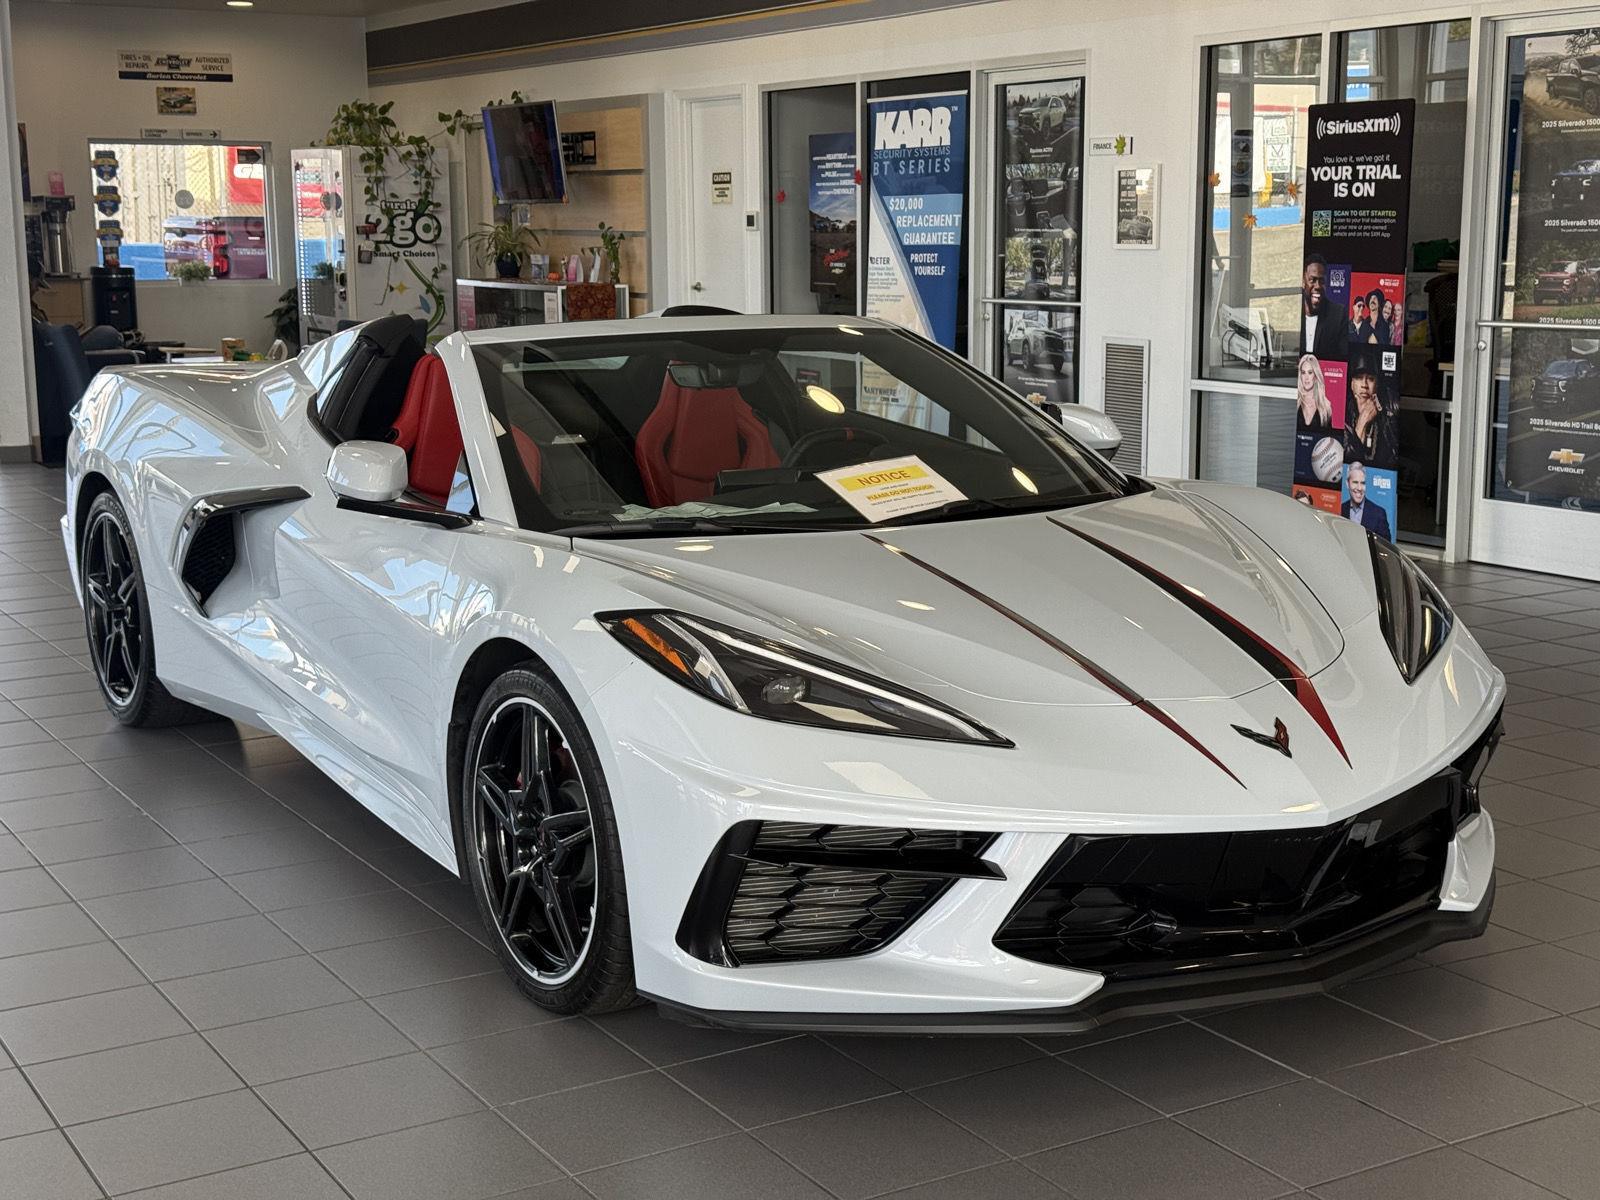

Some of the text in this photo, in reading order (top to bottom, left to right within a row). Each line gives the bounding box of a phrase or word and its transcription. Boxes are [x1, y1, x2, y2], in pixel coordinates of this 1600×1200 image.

[874, 106, 952, 150] KARR
[1558, 119, 1586, 127] Silverado
[874, 146, 950, 160] SECURITY SYSTEMS
[1356, 154, 1372, 162] we've
[1374, 154, 1384, 163] got
[873, 158, 951, 176] BT SERIES
[1311, 164, 1402, 182] YOUR TRIAL
[1334, 182, 1376, 198] IS ON
[890, 198, 924, 212] $20,000
[896, 214, 962, 228] REPLACEMENT
[904, 232, 955, 245] GUARANTEE
[910, 253, 938, 263] PROTECT
[914, 266, 946, 276] YOURSELF
[1530, 417, 1544, 426] 2025
[1545, 419, 1570, 428] Silverado
[1581, 422, 1593, 430] Trail
[1548, 466, 1584, 475] CHEVROLET
[857, 470, 910, 486] NOTICE
